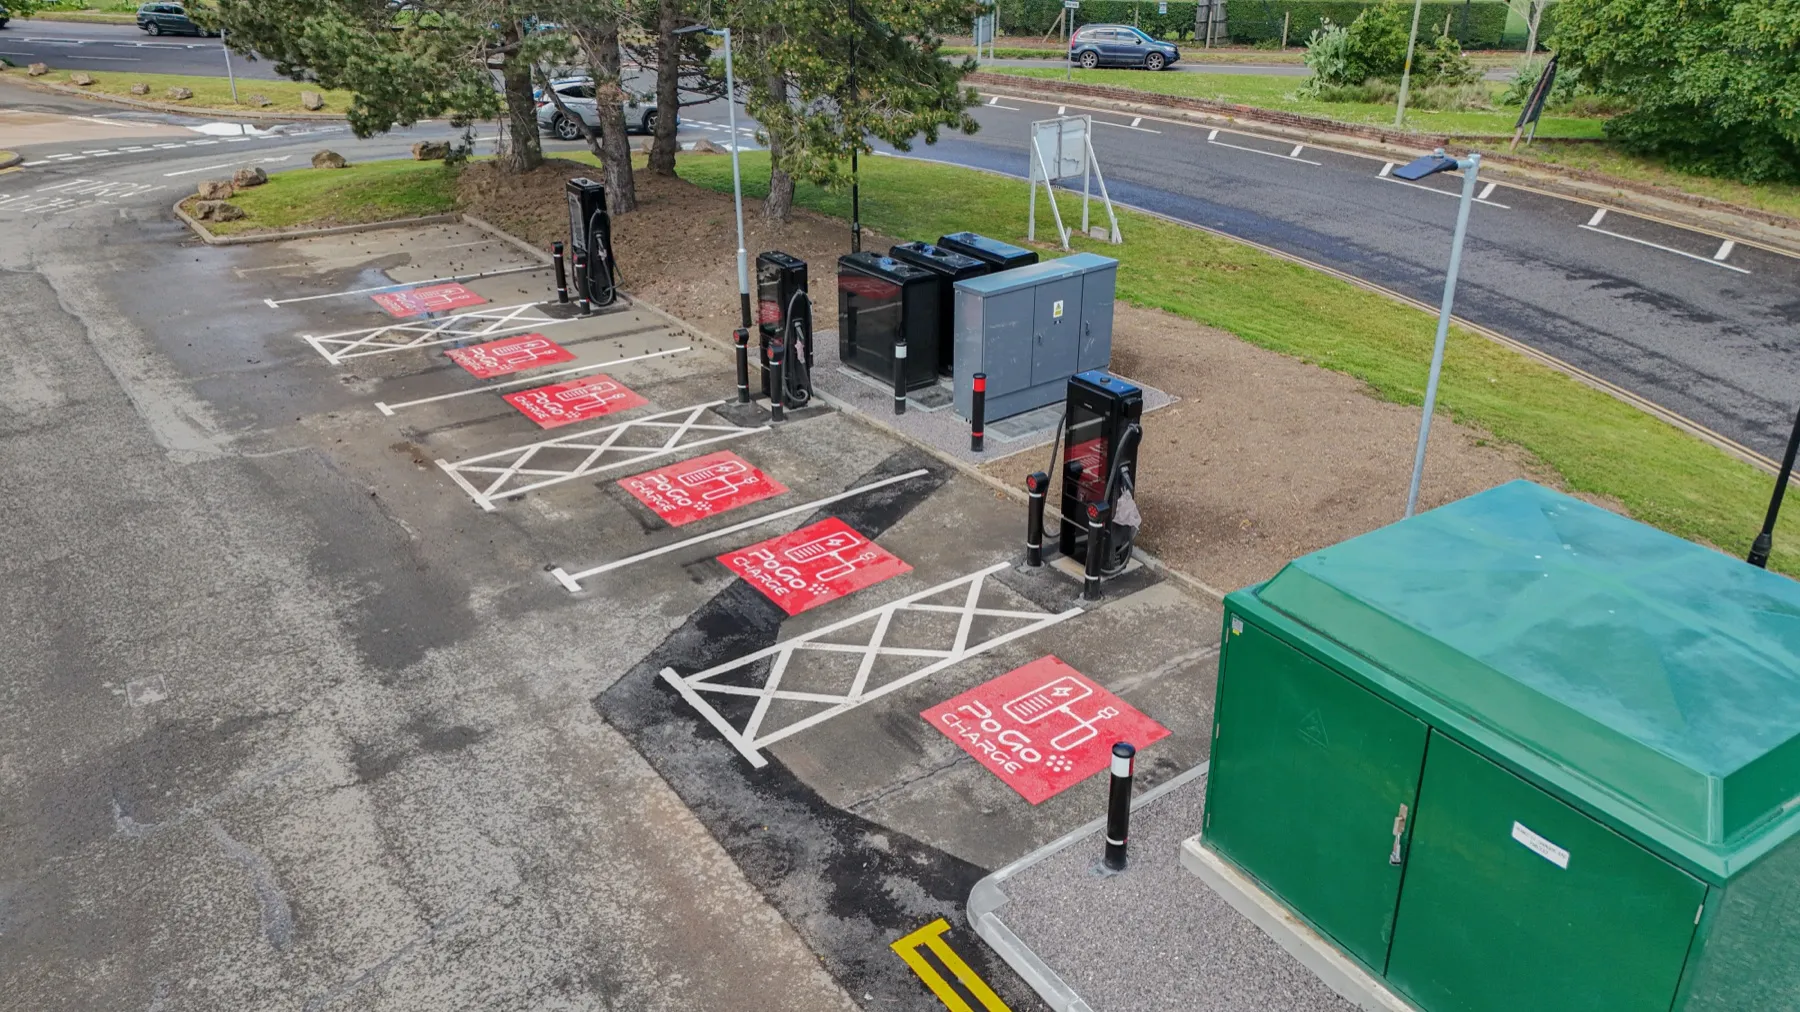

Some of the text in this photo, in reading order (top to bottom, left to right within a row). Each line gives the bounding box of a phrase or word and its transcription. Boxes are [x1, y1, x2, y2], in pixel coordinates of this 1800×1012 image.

[36, 179, 167, 199] TURN
[514, 396, 549, 420] CHARGE
[630, 480, 677, 512] CHARGE
[733, 556, 790, 597] CHARGE
[941, 712, 1023, 775] CHARGE
